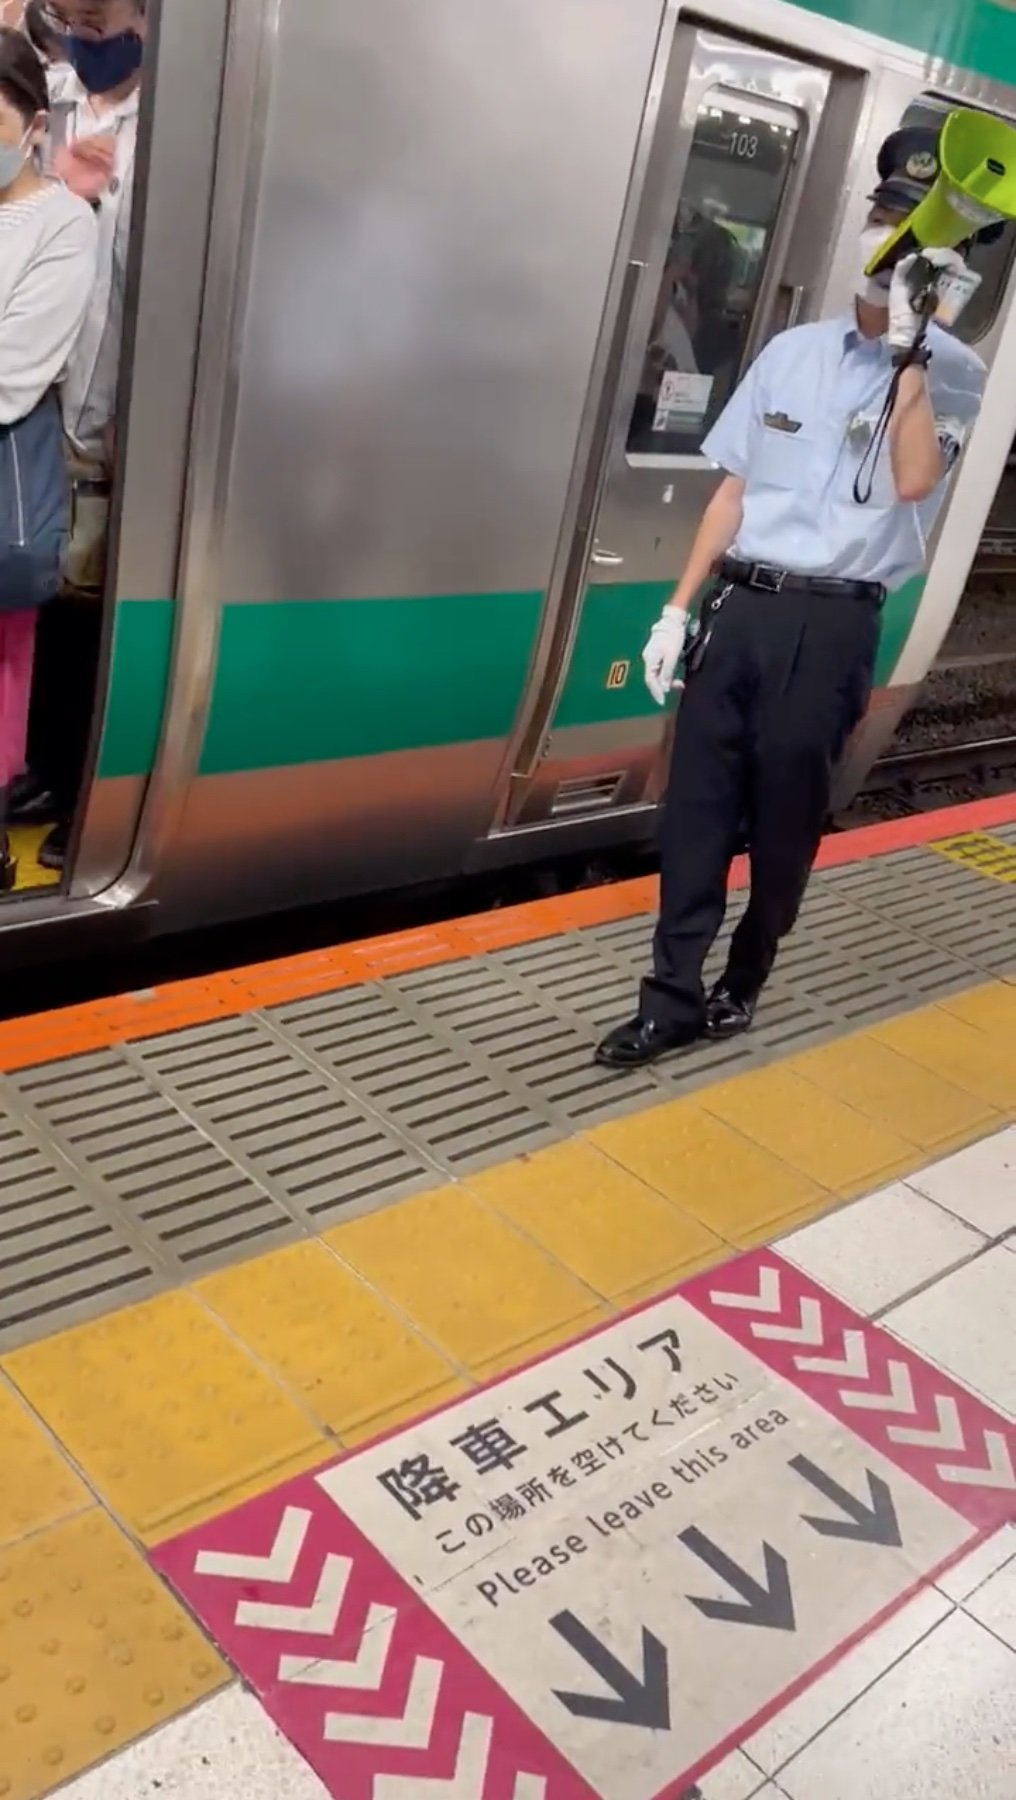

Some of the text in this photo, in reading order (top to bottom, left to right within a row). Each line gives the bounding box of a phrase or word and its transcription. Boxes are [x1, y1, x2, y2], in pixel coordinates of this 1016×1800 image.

[730, 132, 758, 158] 103
[610, 663, 626, 685] 10
[376, 1328, 681, 1521] 降車エリア
[435, 1372, 740, 1556] この場所を空けてください
[475, 1408, 790, 1608] Please leave this area
